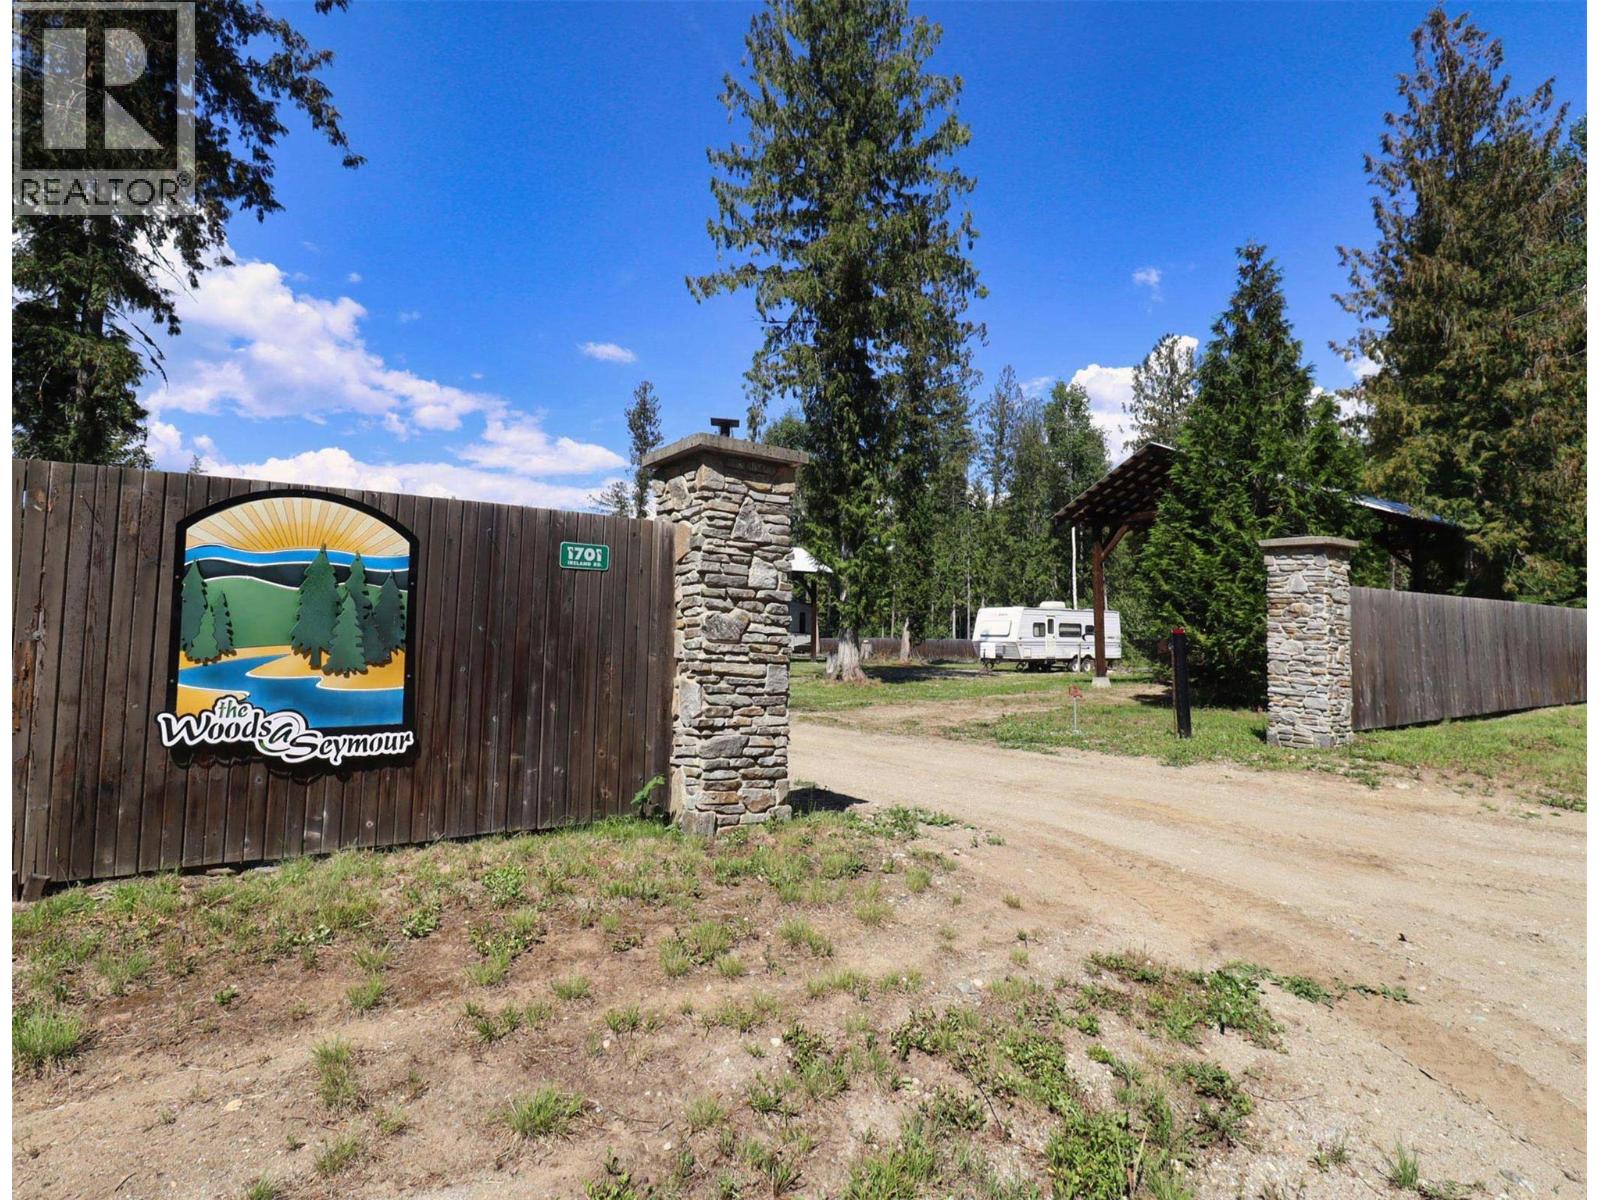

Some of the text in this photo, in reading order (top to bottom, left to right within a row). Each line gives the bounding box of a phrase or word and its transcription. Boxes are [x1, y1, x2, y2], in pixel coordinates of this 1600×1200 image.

[567, 546, 602, 562] 1701
[218, 700, 248, 719] the
[289, 731, 412, 762] Seymour
